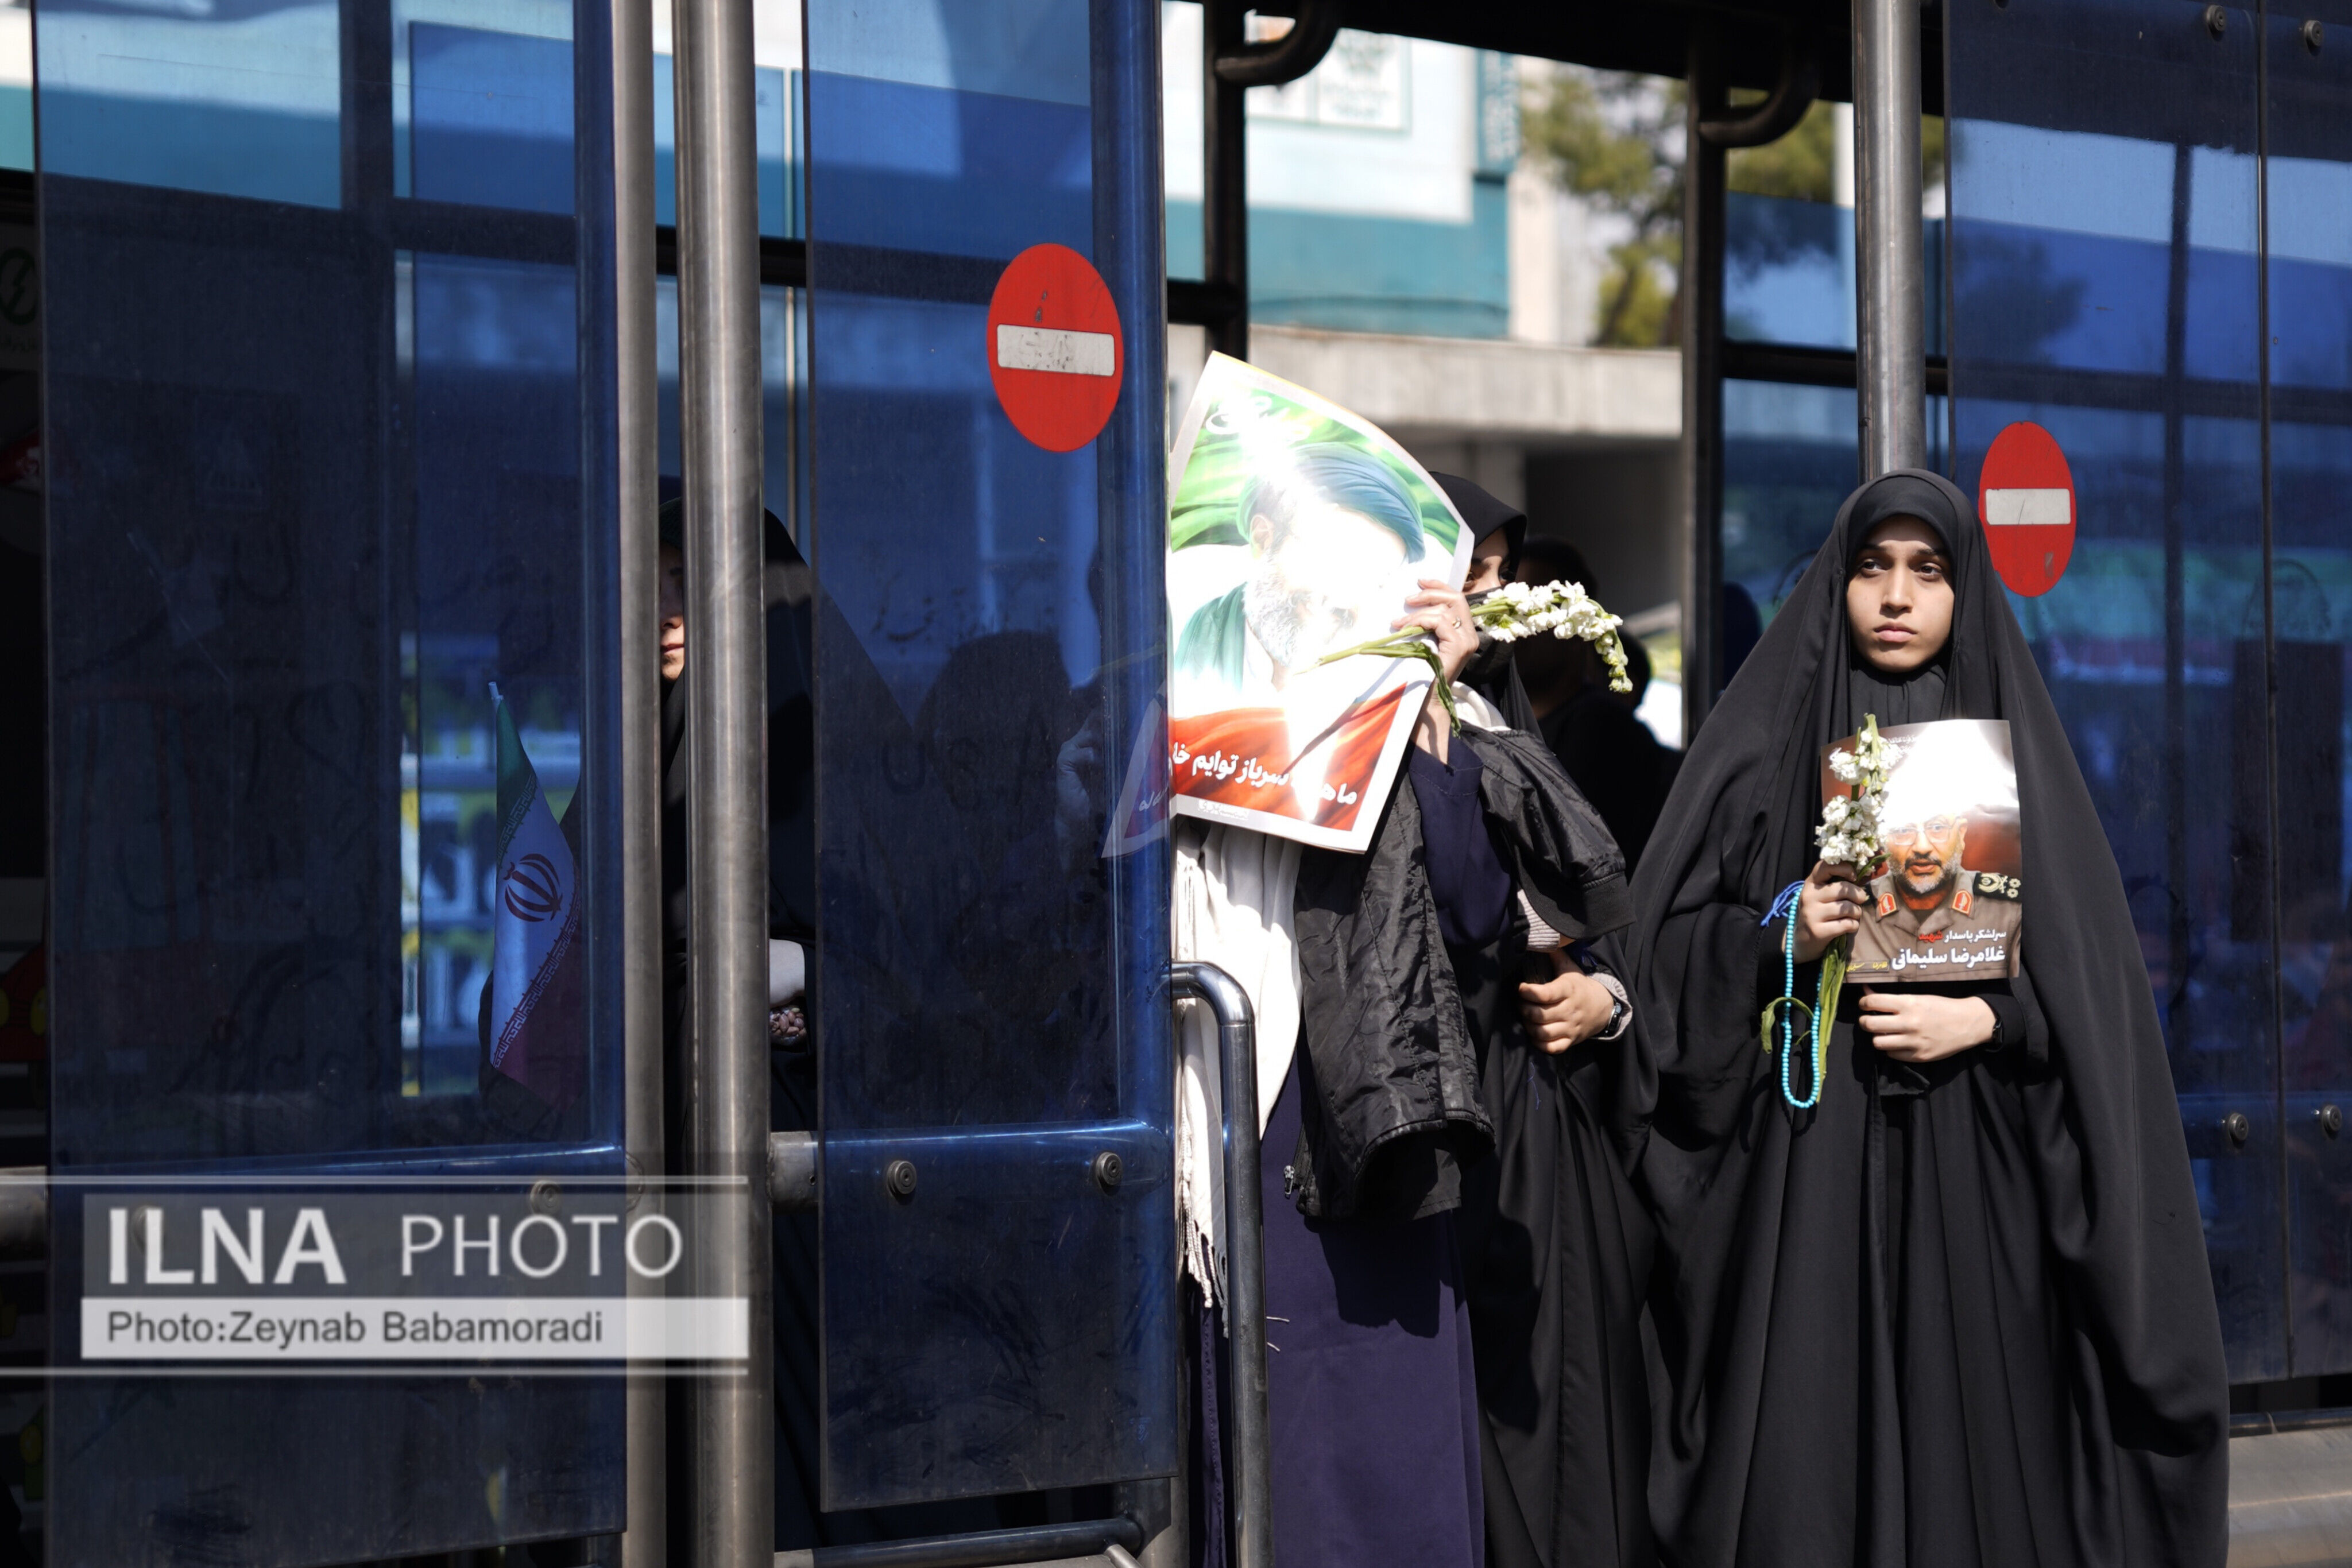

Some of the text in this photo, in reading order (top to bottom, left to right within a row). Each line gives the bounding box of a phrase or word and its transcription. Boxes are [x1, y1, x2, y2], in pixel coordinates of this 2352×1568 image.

[1192, 750, 1239, 780] توایم
[1235, 757, 1290, 788] سرباز
[1337, 783, 1357, 804] ما
[1918, 929, 2006, 943] سرلشکر پاسدار شهید
[1891, 945, 2006, 970] غلامرضا سلیمانی
